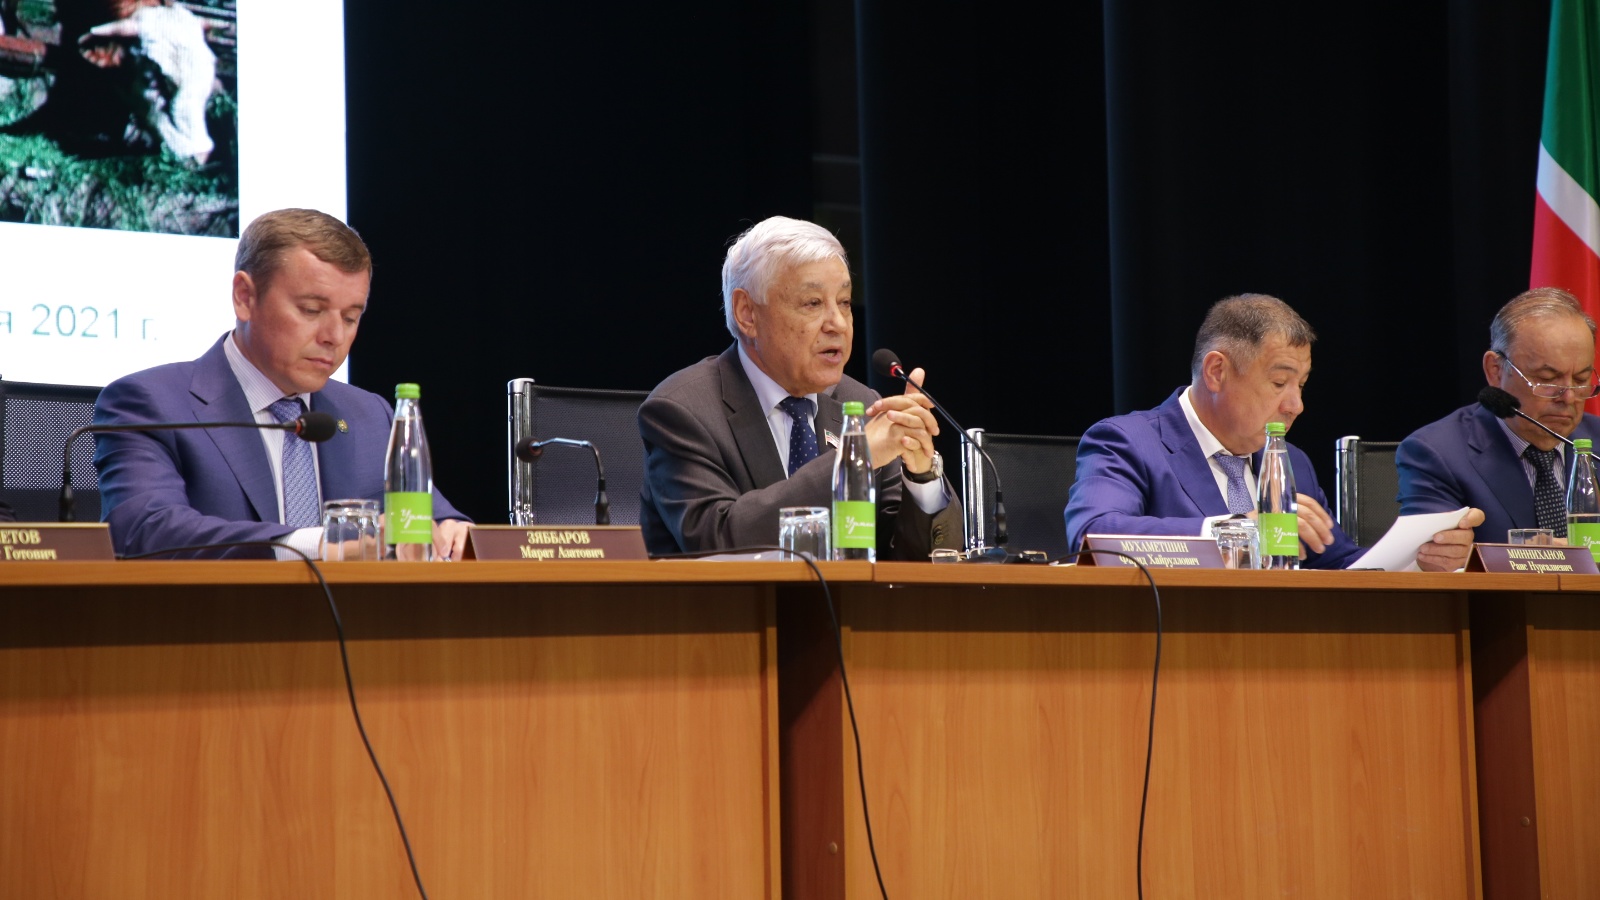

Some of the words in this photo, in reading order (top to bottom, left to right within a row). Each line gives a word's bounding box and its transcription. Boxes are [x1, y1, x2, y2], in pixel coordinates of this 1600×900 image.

[32, 303, 118, 338] 2021
[142, 318, 157, 340] г.
[0, 529, 41, 545] ЕТОВ
[527, 531, 591, 544] ЗЯББАРОВ
[3, 545, 57, 560] Готович
[520, 545, 555, 561] Марат
[558, 546, 605, 559] Азатович
[1120, 541, 1189, 553] МУХАМЕТШИН
[1506, 548, 1566, 560] МИННИХАНОВ
[1146, 553, 1200, 568] Хайруллович
[1508, 560, 1529, 571] Раис
[1527, 560, 1574, 574] Нургалиевич
